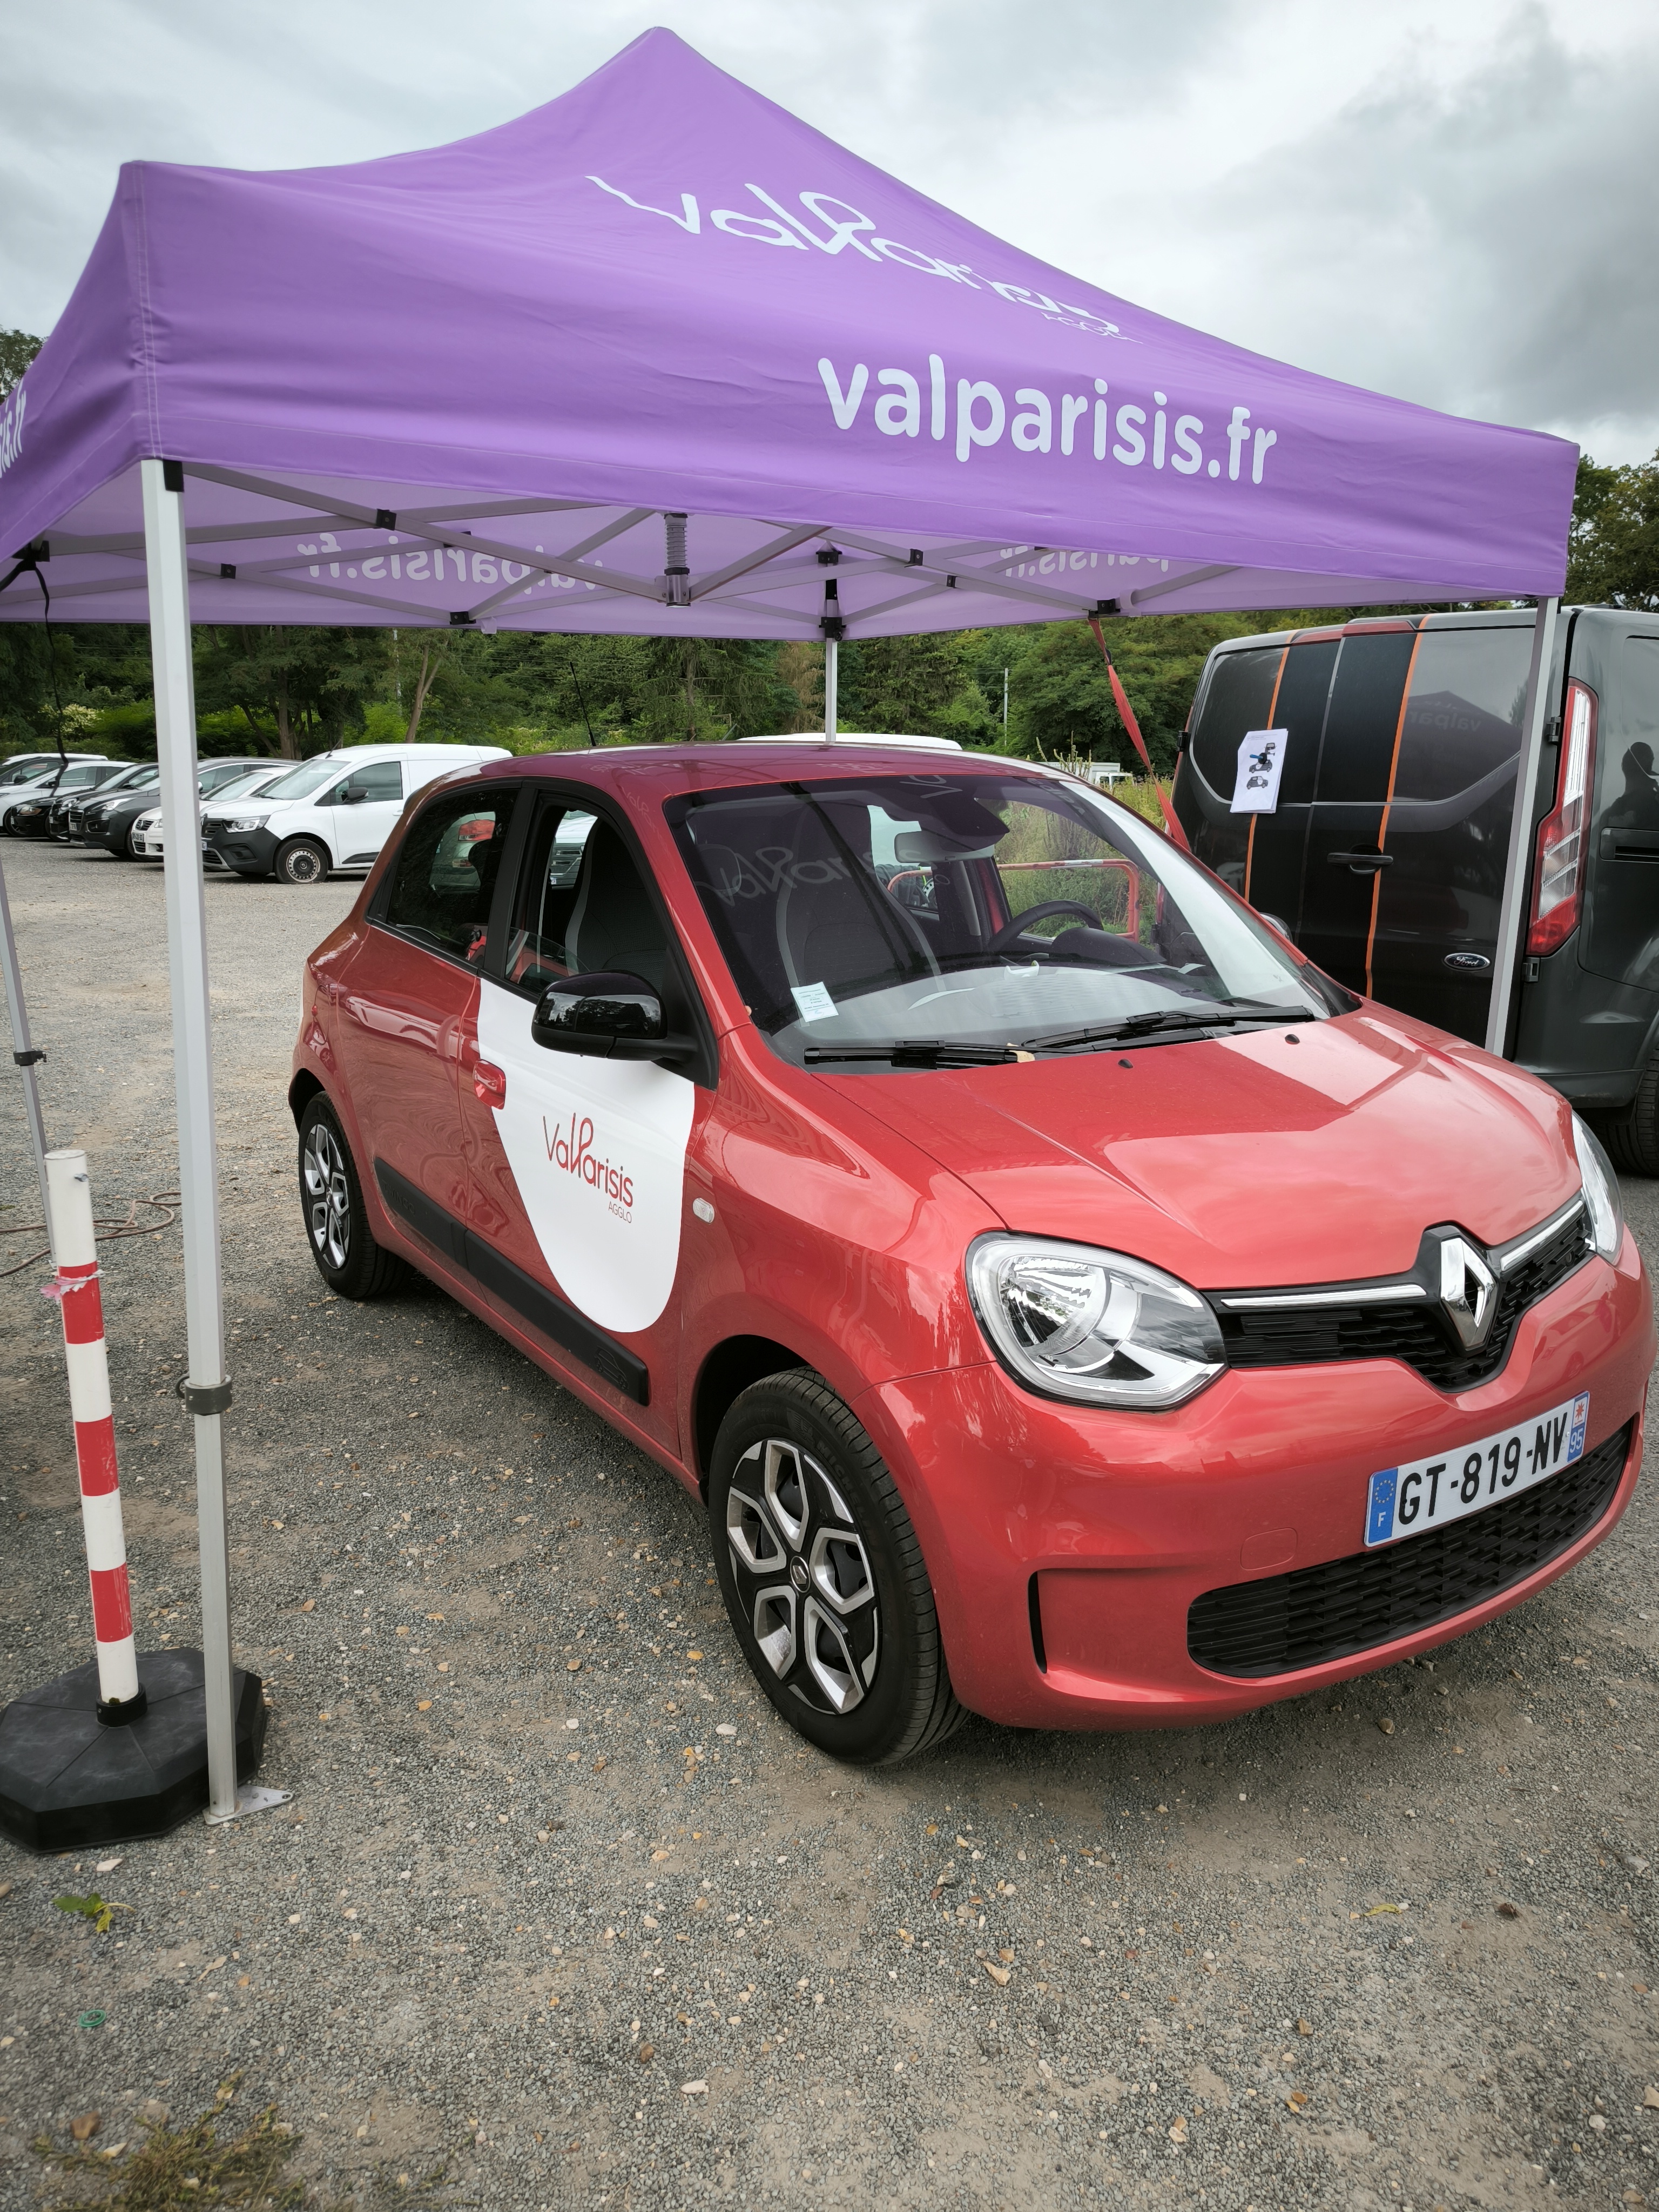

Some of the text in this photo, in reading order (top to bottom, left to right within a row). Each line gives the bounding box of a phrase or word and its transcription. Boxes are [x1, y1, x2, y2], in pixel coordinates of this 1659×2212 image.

[817, 353, 1278, 484] valparisis.fr
[1454, 956, 1479, 967] Ford
[543, 1112, 633, 1208] ValParisis
[608, 1201, 632, 1224] AGGLO
[1569, 1427, 1583, 1454] 95
[1398, 1412, 1568, 1525] GT-819-NV
[1377, 1512, 1386, 1528] F
